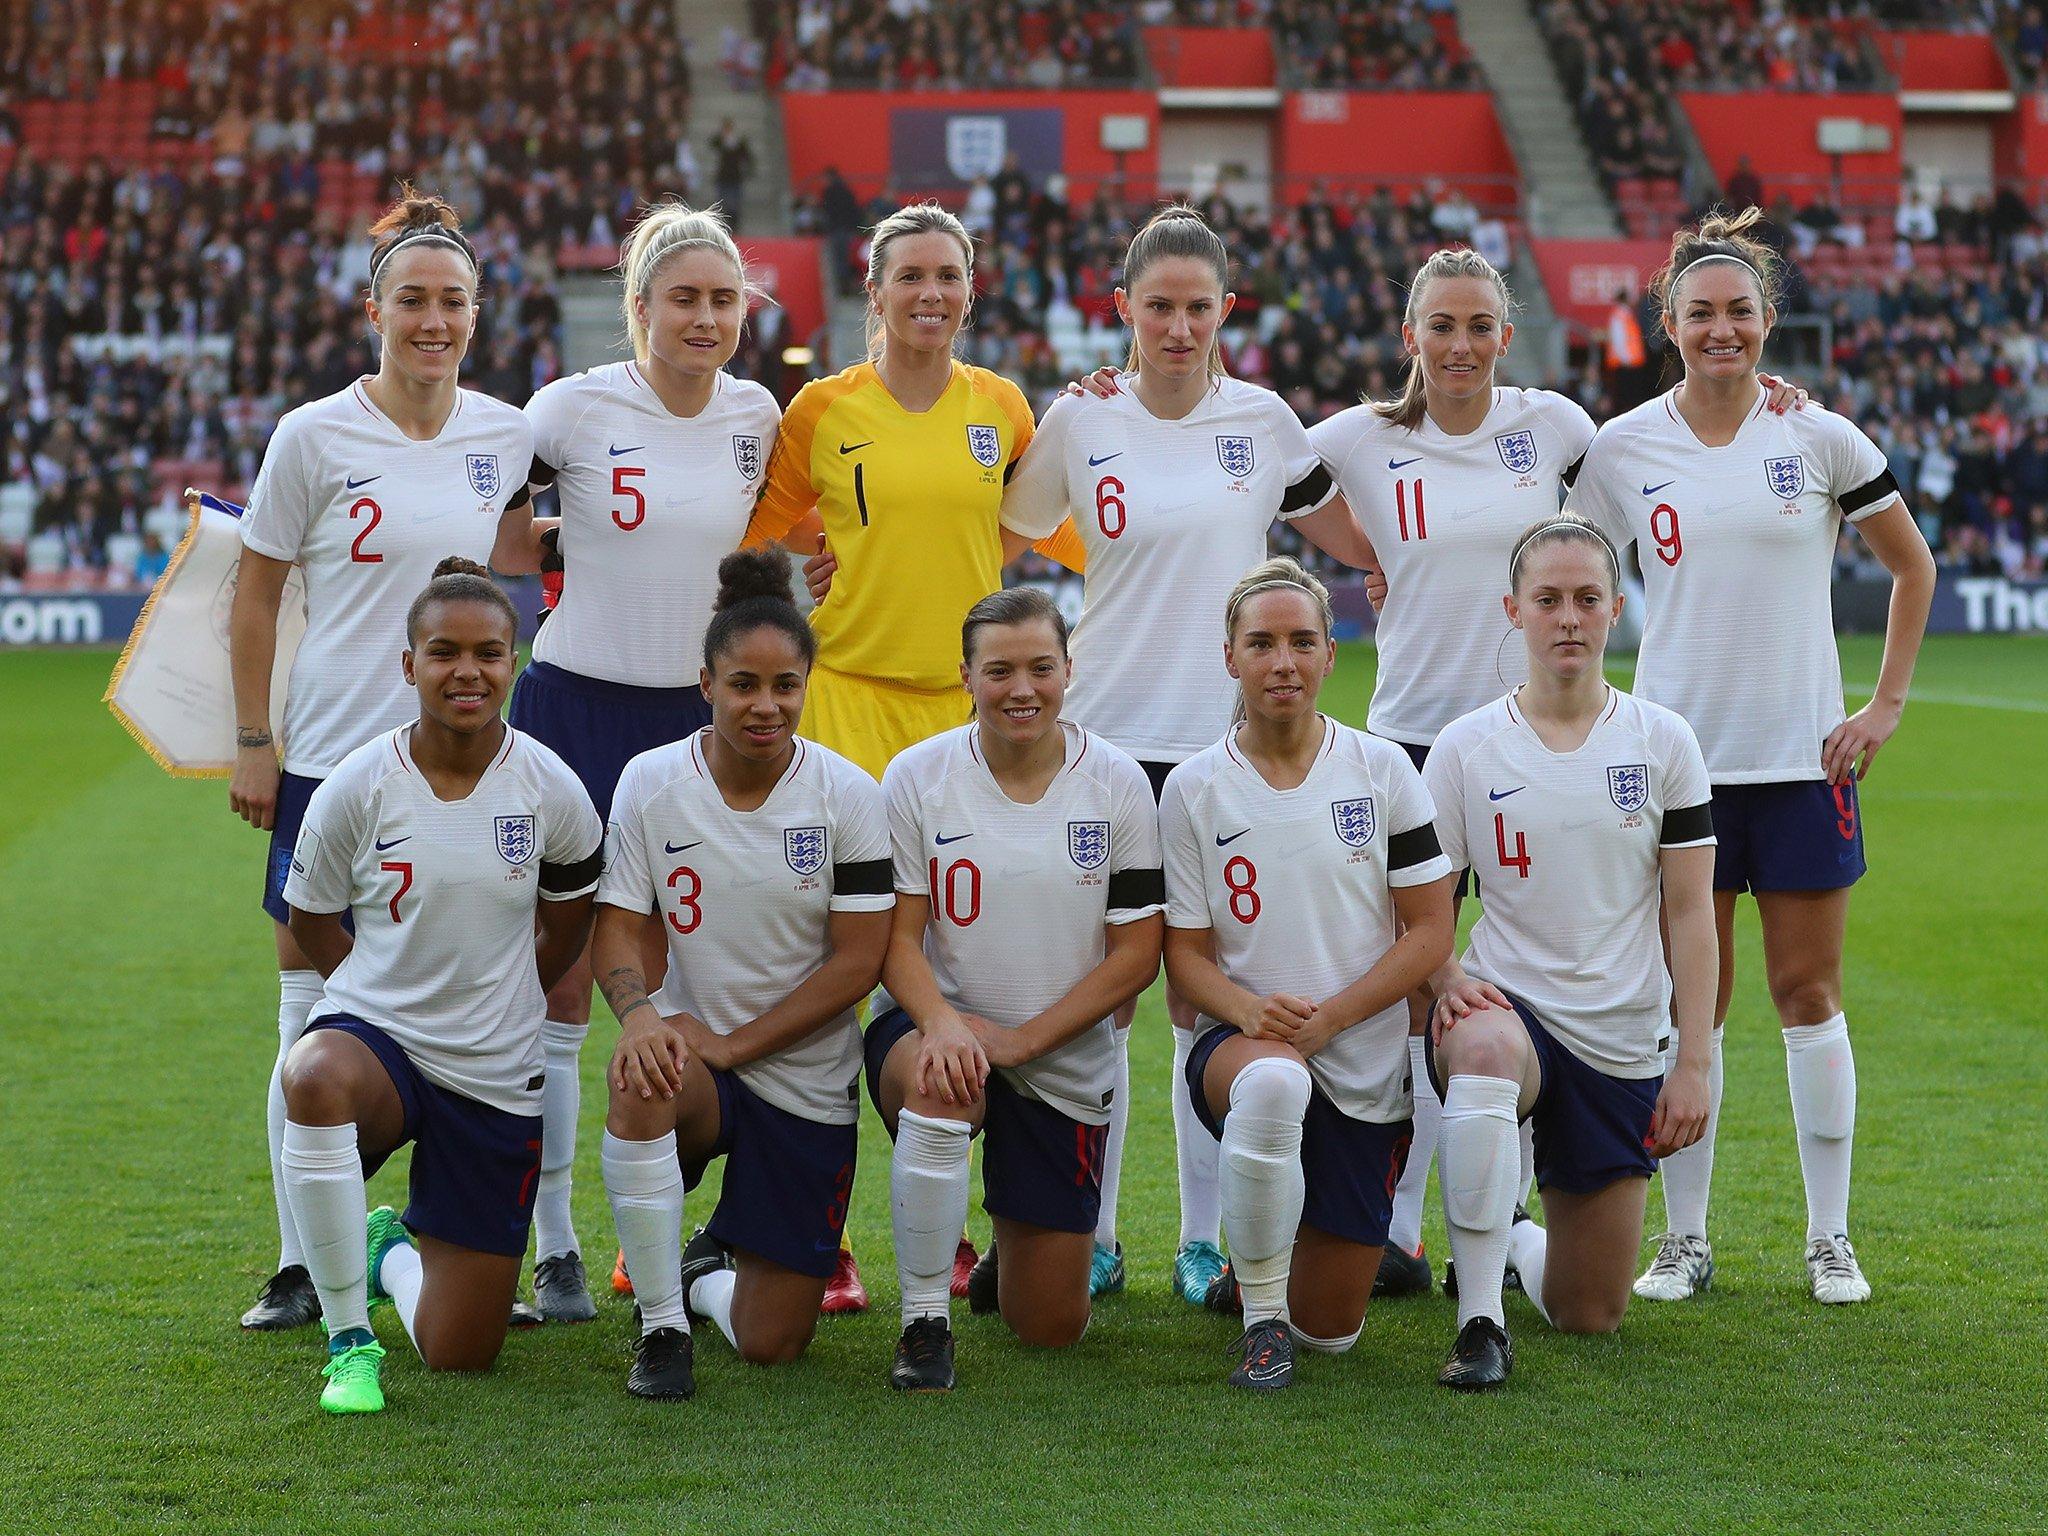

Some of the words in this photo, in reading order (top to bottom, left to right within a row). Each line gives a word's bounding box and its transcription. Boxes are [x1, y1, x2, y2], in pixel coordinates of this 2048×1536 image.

[611, 467, 646, 532] 5
[854, 462, 869, 527] 1
[1096, 475, 1127, 540] 6
[1395, 479, 1427, 541] 11
[349, 497, 383, 563] 2
[1650, 503, 1683, 567] 9
[1832, 777, 1857, 841] 9
[1495, 812, 1532, 878] 4
[380, 861, 413, 923] 7
[666, 866, 702, 935] 3
[928, 857, 981, 927] 10
[1223, 855, 1261, 925] 8
